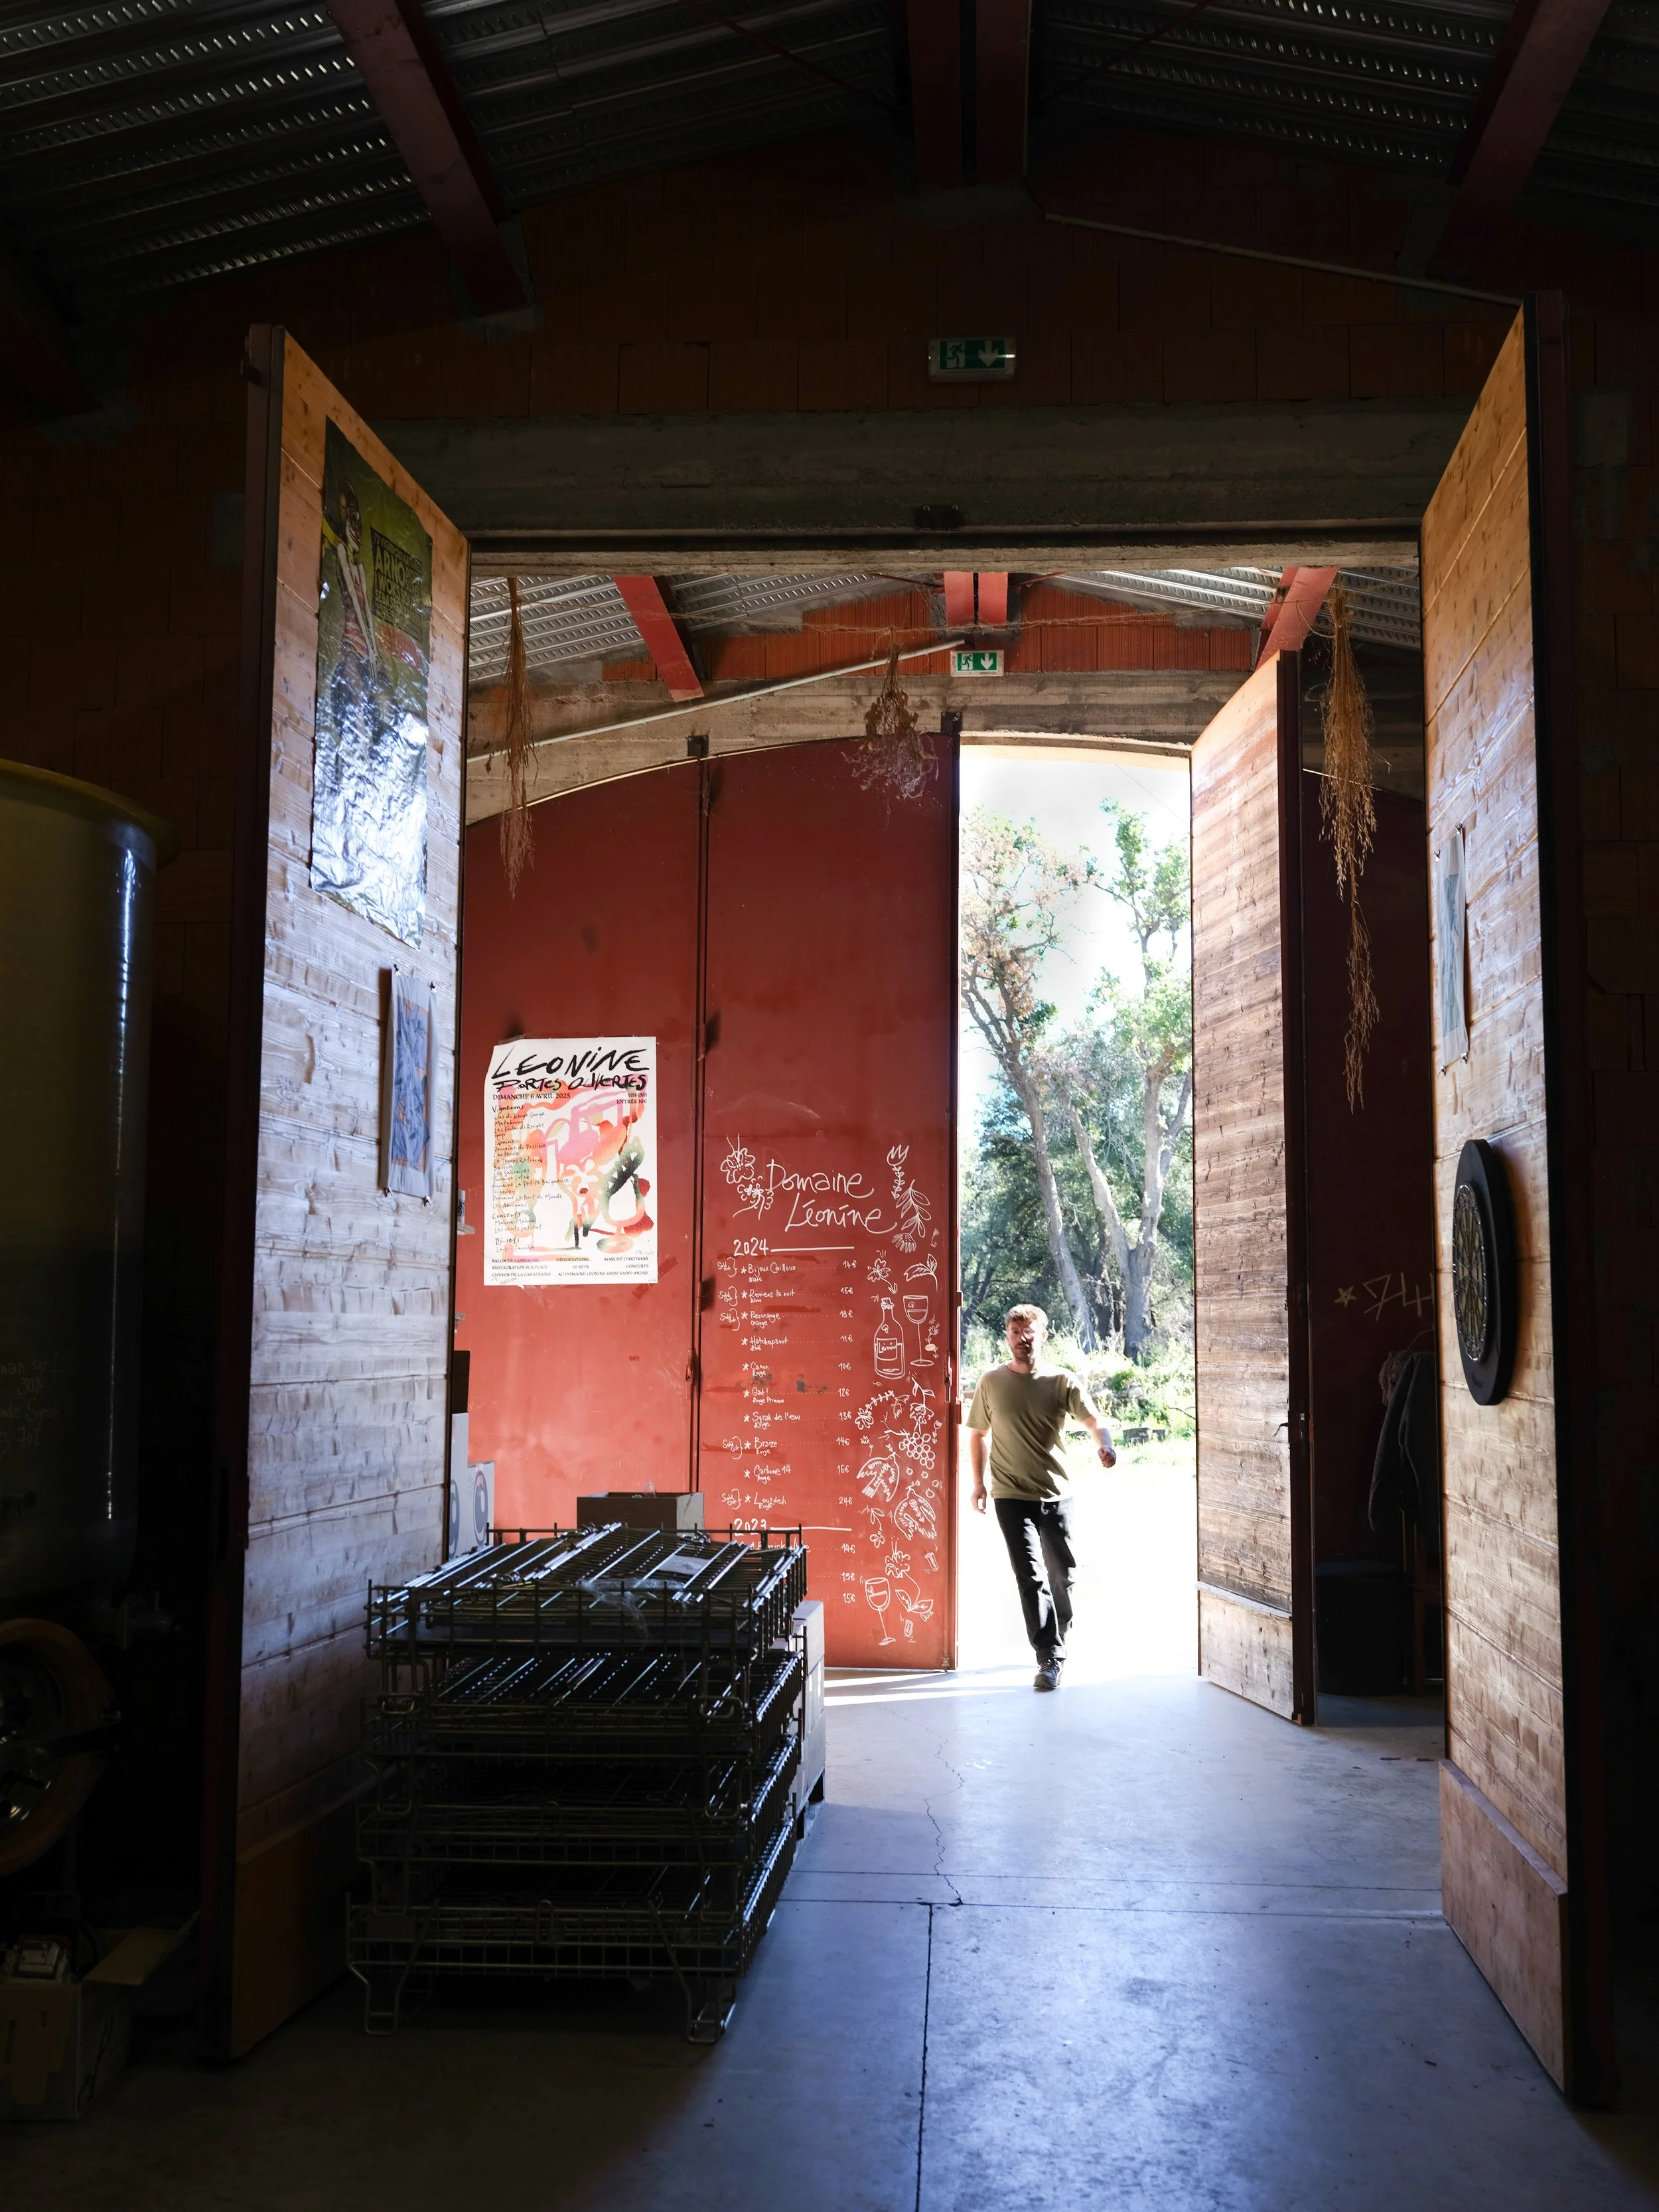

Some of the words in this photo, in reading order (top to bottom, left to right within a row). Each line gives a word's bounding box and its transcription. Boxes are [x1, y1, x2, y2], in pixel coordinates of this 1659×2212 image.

[376, 545, 406, 588] ARNO
[492, 1105, 524, 1114] Vignerons
[766, 1158, 874, 1199] Domaine
[784, 1193, 898, 1234] Léonine
[733, 1237, 769, 1256] 2024
[748, 1263, 769, 1278] Bijoux
[783, 1288, 796, 1297] nuit
[750, 1361, 769, 1370] Canon
[753, 1464, 781, 1477] Carbone
[781, 1464, 792, 1474] 14
